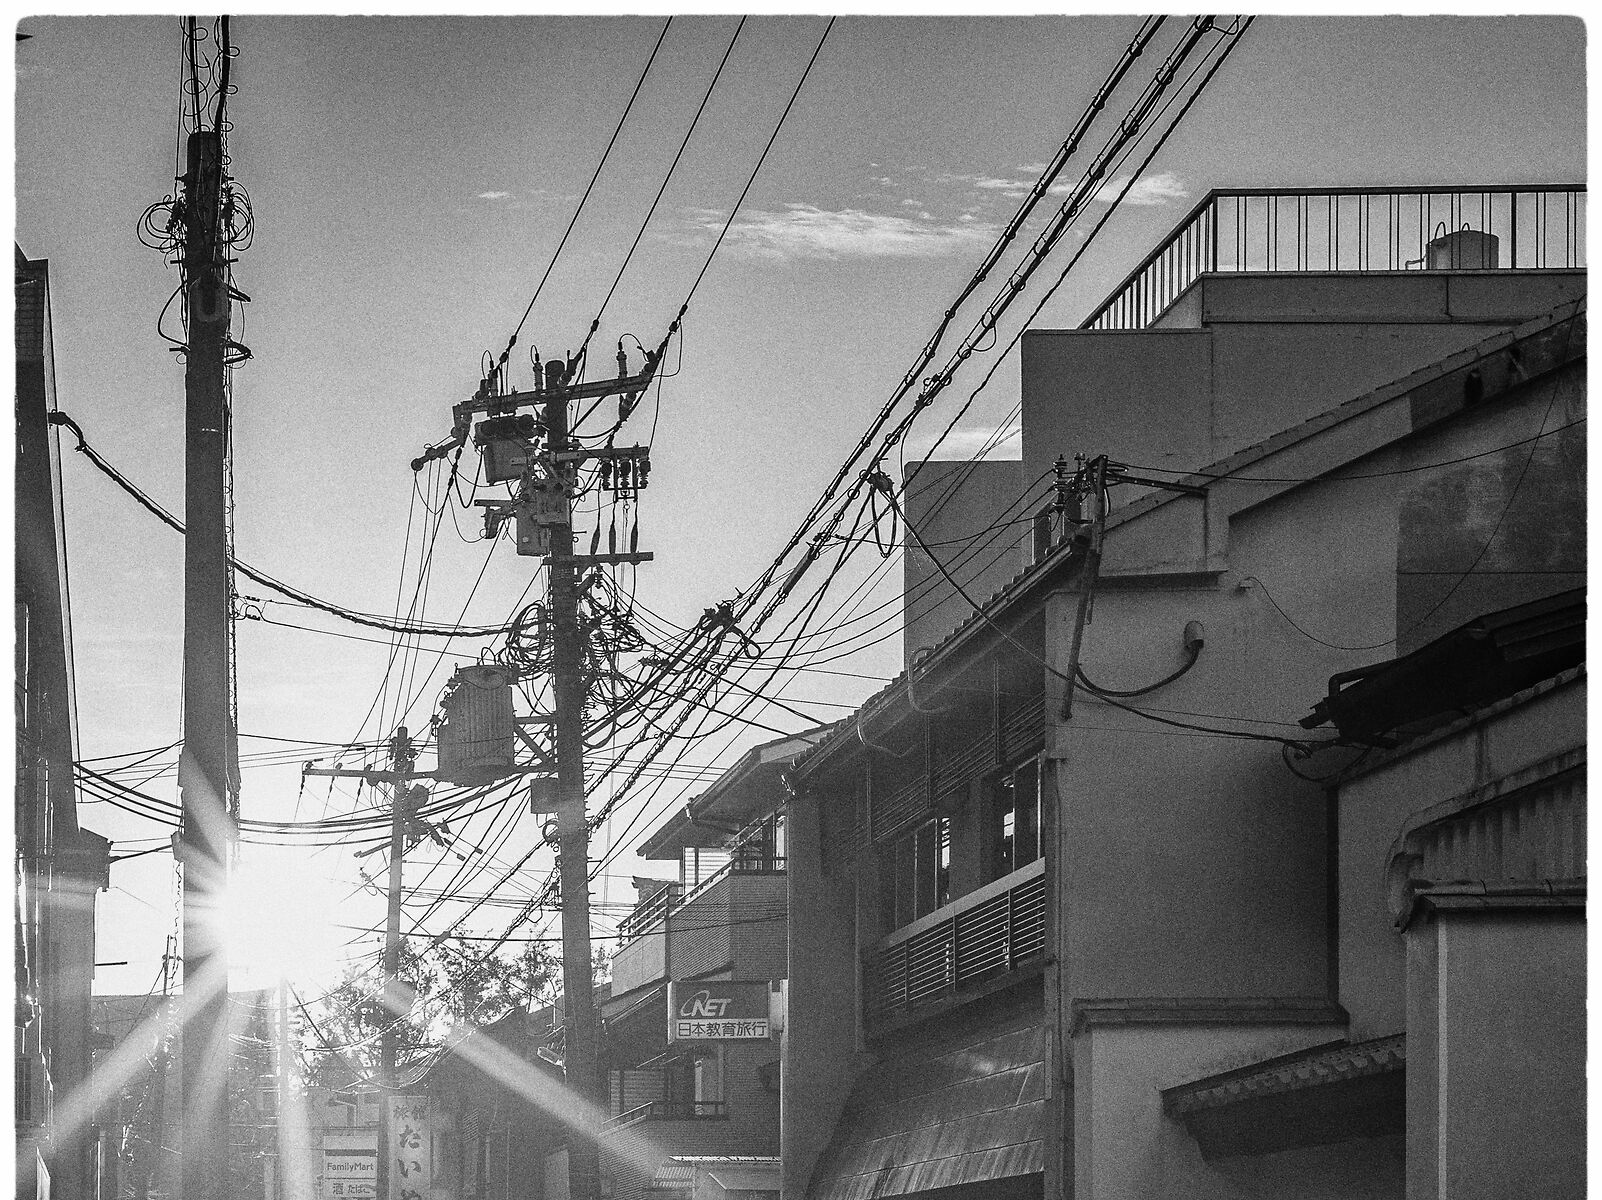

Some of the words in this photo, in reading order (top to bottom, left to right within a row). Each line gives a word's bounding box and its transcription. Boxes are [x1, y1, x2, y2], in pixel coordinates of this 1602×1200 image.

[678, 1021, 767, 1037] 日本教育旅行
[327, 1162, 374, 1172] FamilyMart
